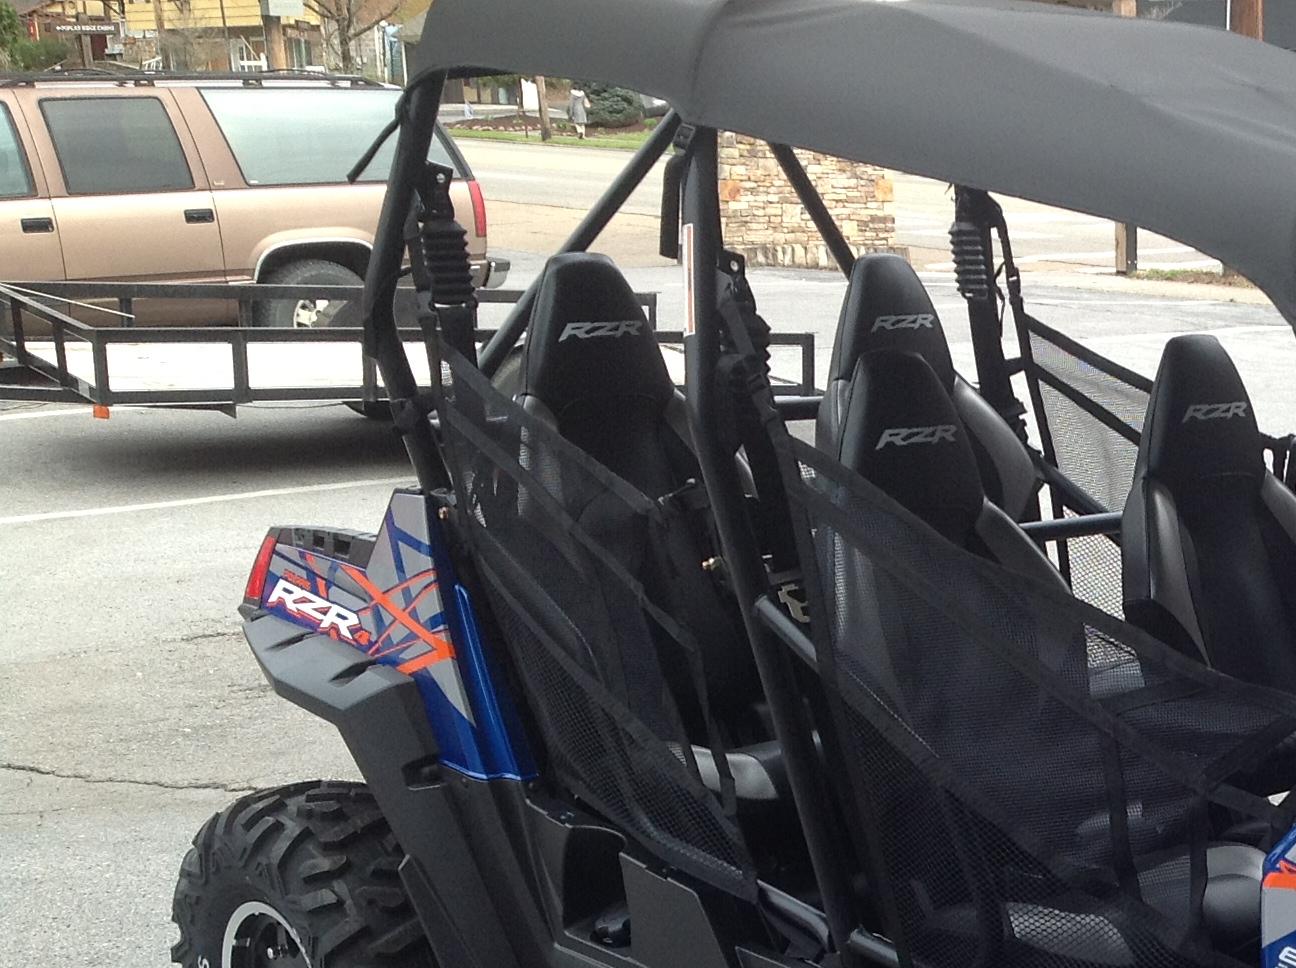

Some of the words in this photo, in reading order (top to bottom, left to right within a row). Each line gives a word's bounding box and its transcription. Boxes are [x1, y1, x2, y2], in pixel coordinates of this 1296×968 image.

[558, 320, 642, 342] RZR
[870, 313, 935, 334] RZR
[1182, 401, 1247, 423] RZR
[875, 424, 957, 450] RZR
[266, 577, 361, 641] RZR
